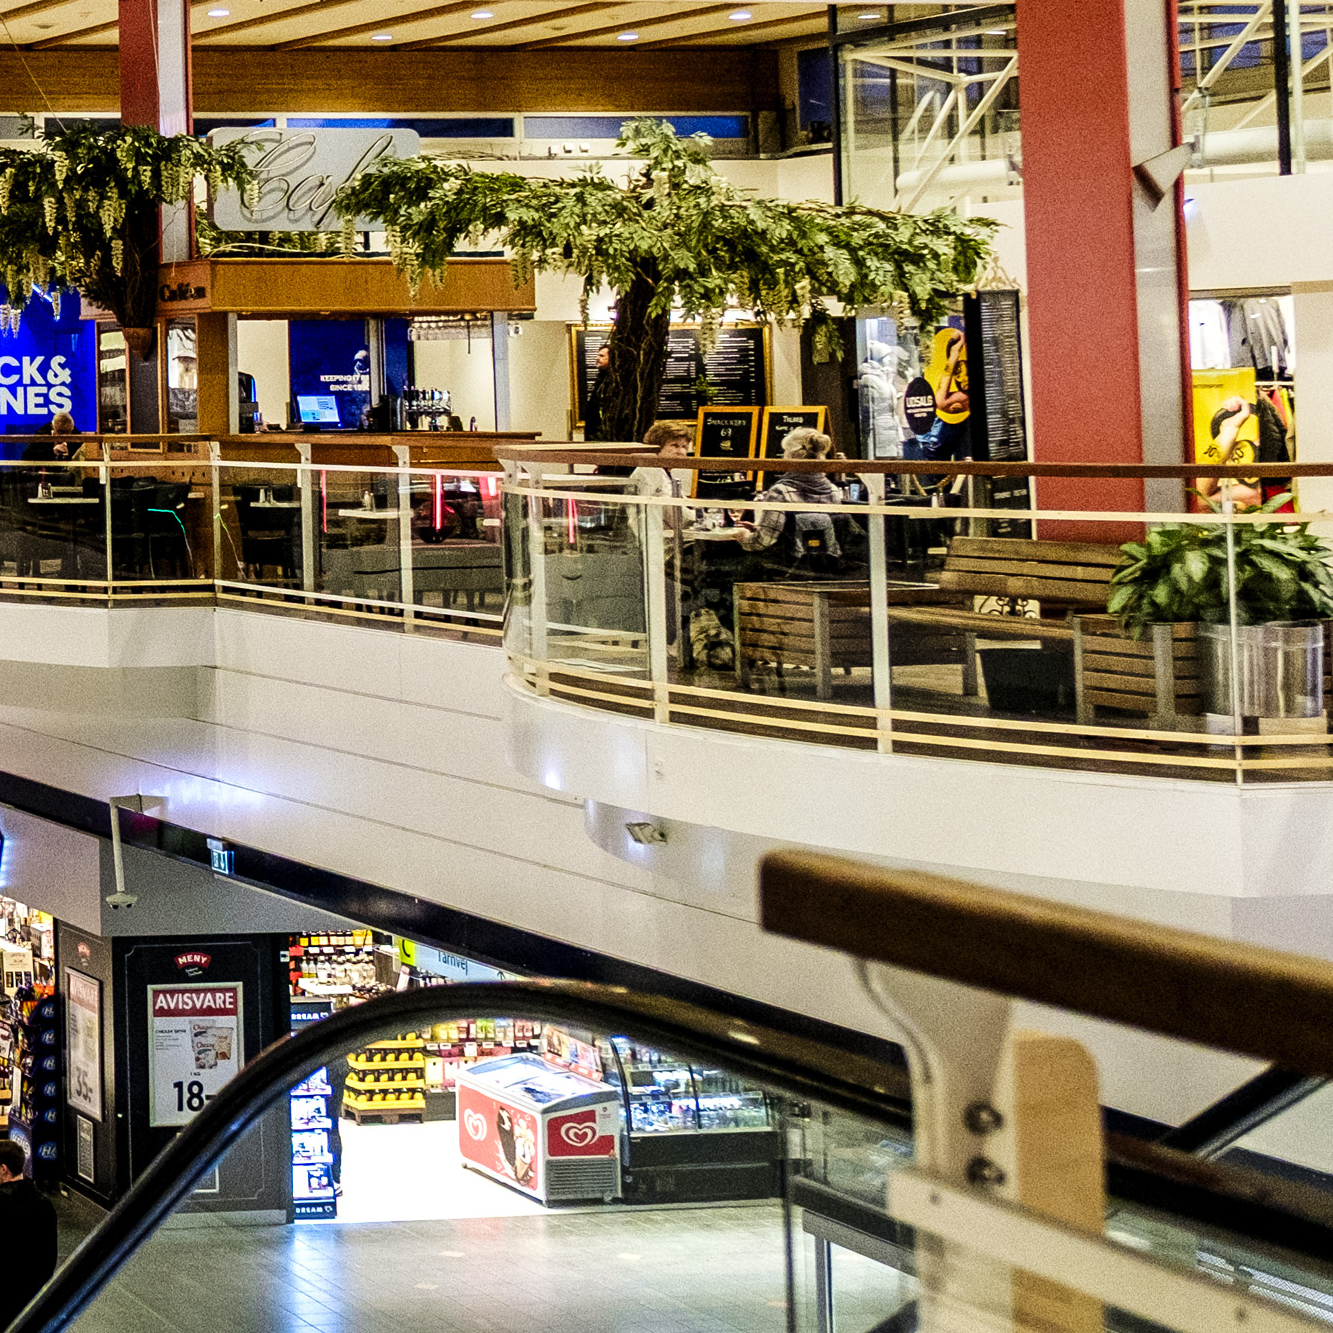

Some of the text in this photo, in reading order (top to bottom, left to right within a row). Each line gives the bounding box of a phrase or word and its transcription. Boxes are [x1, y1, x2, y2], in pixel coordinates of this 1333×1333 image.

[240, 129, 395, 230] Caf
[177, 954, 208, 965] MENY
[155, 992, 234, 1010] AVISVARE
